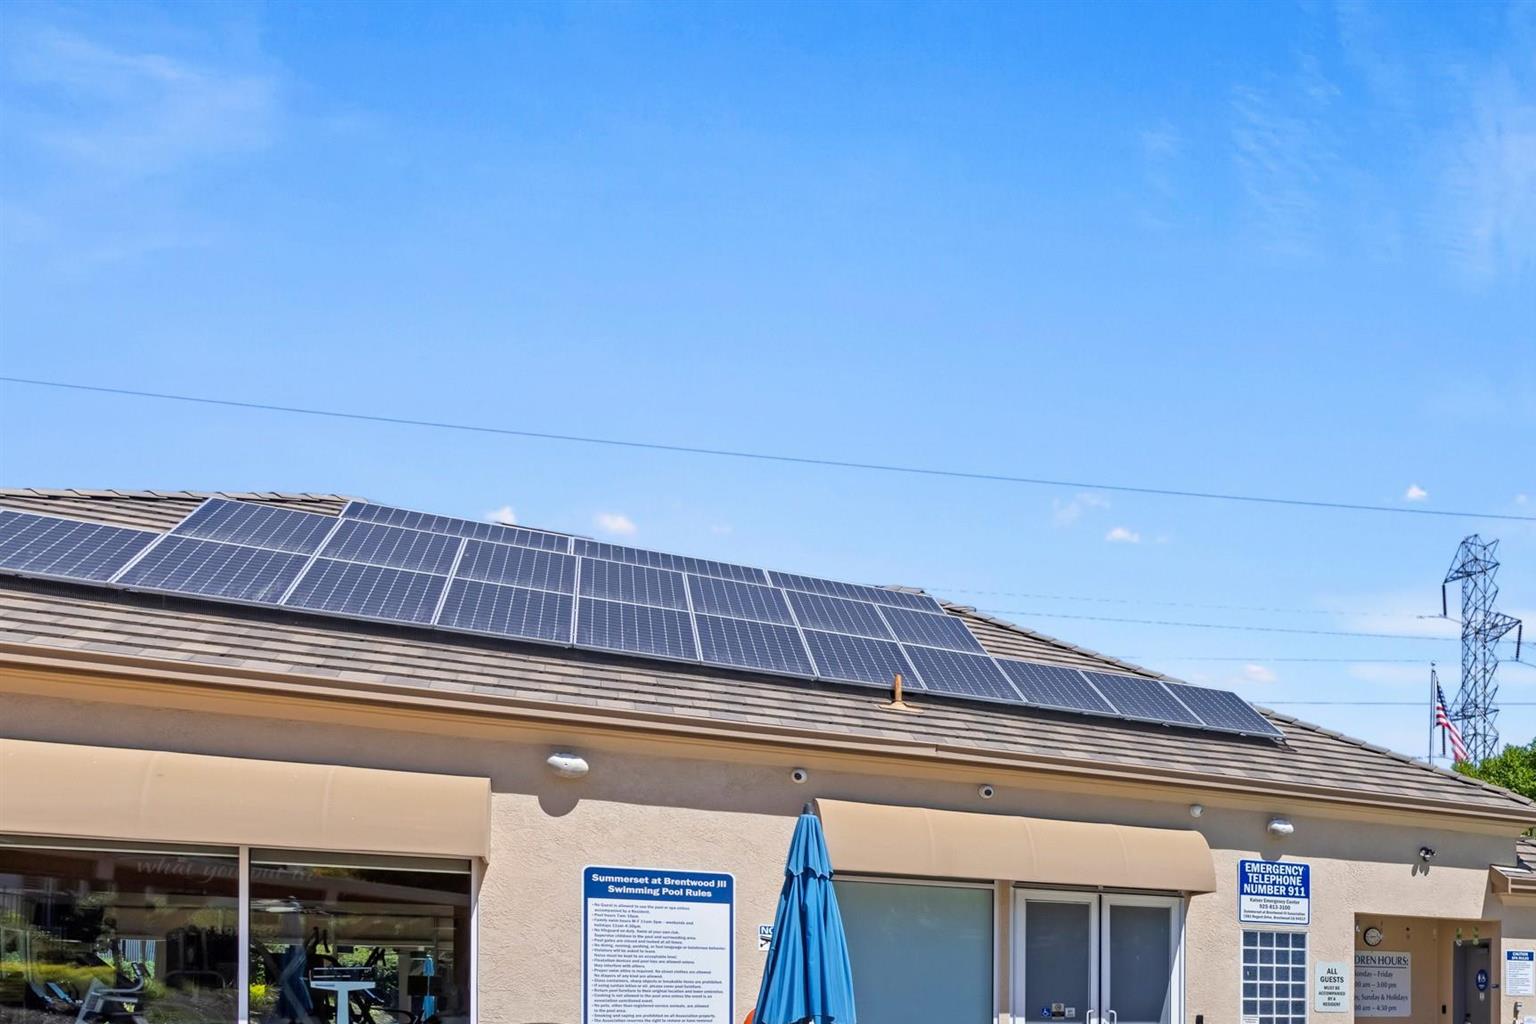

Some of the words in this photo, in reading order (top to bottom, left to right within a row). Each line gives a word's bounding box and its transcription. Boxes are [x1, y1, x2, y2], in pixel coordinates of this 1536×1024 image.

[1245, 862, 1304, 876] EMERGENCY
[592, 874, 649, 884] Summerset
[651, 877, 662, 885] at
[664, 877, 715, 887] Brentwood
[1248, 873, 1303, 886] TELEPHONE
[608, 885, 660, 896] Swimming
[662, 887, 683, 896] Pool
[686, 888, 712, 897] Rules
[1244, 884, 1286, 895] NUMBER
[1288, 886, 1306, 897] 911
[1378, 955, 1409, 966] HOURS:
